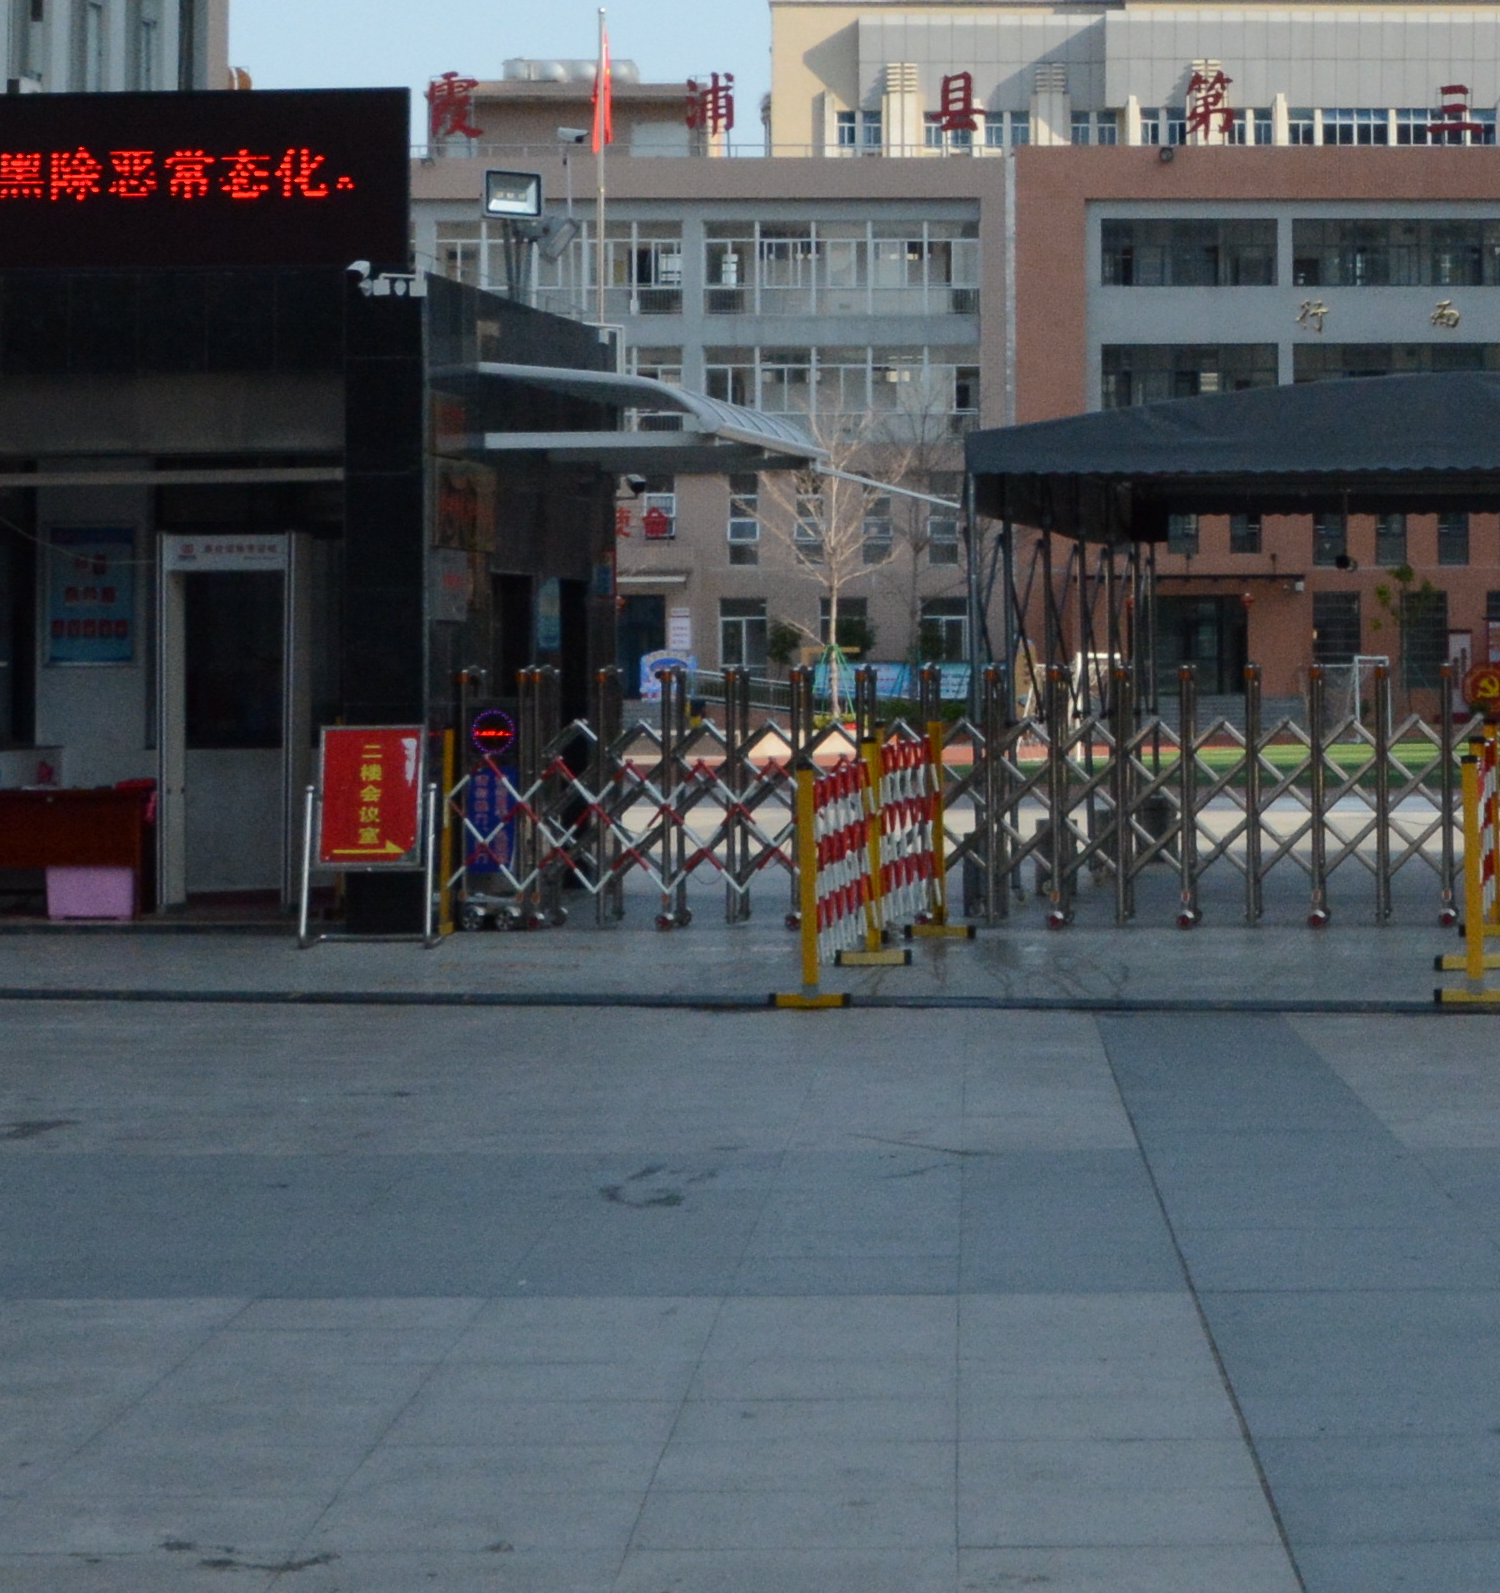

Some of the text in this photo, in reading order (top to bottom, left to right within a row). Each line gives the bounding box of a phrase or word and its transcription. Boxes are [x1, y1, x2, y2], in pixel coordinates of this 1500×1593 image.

[358, 743, 384, 845] 二楼会议室
